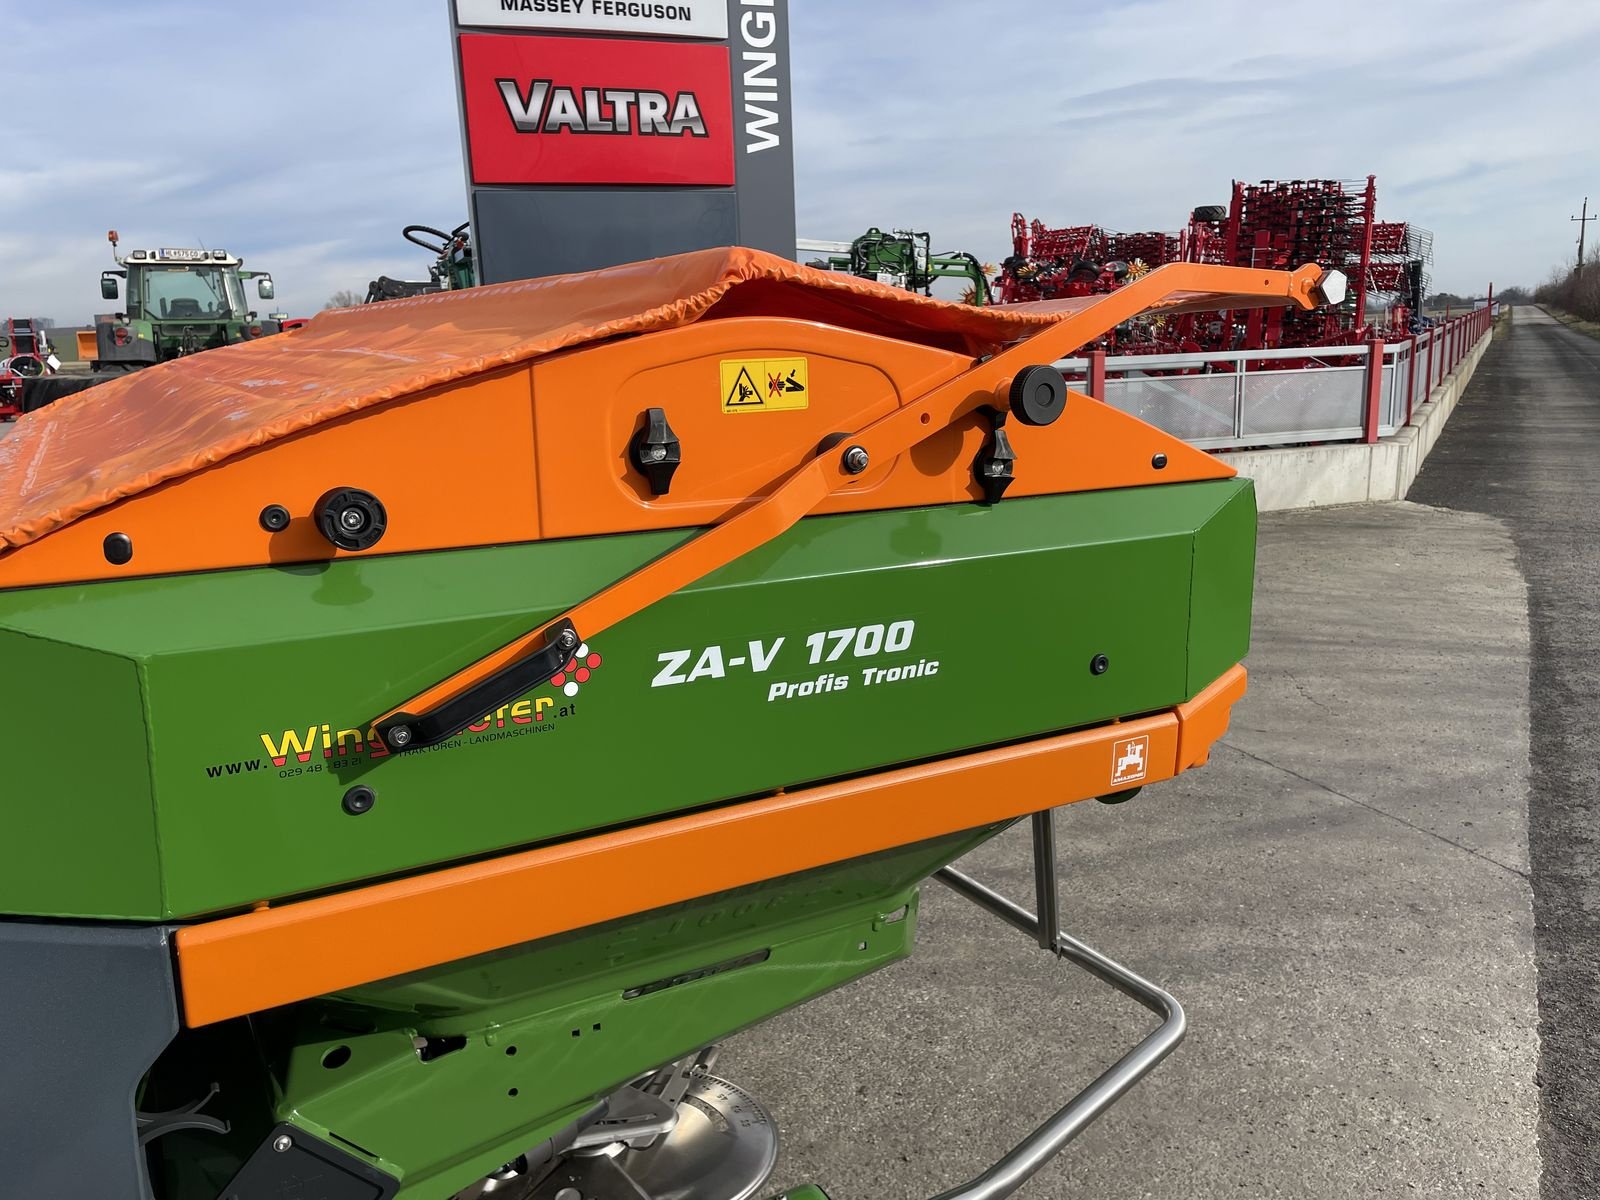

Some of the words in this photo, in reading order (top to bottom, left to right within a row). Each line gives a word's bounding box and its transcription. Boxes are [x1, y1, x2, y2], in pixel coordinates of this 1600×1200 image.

[501, 0, 585, 14] MASSEY
[592, 0, 691, 21] FERGUSON
[740, 0, 781, 154] WING
[495, 78, 709, 138] VALTRA
[651, 636, 786, 687] ZA-V
[806, 620, 915, 665] 1700
[767, 673, 849, 701] Profis
[862, 659, 940, 686] Tronic
[470, 723, 555, 745] LANDMASCHINEN
[279, 767, 303, 779] 029
[306, 764, 323, 775] 48
[332, 758, 348, 769] 83
